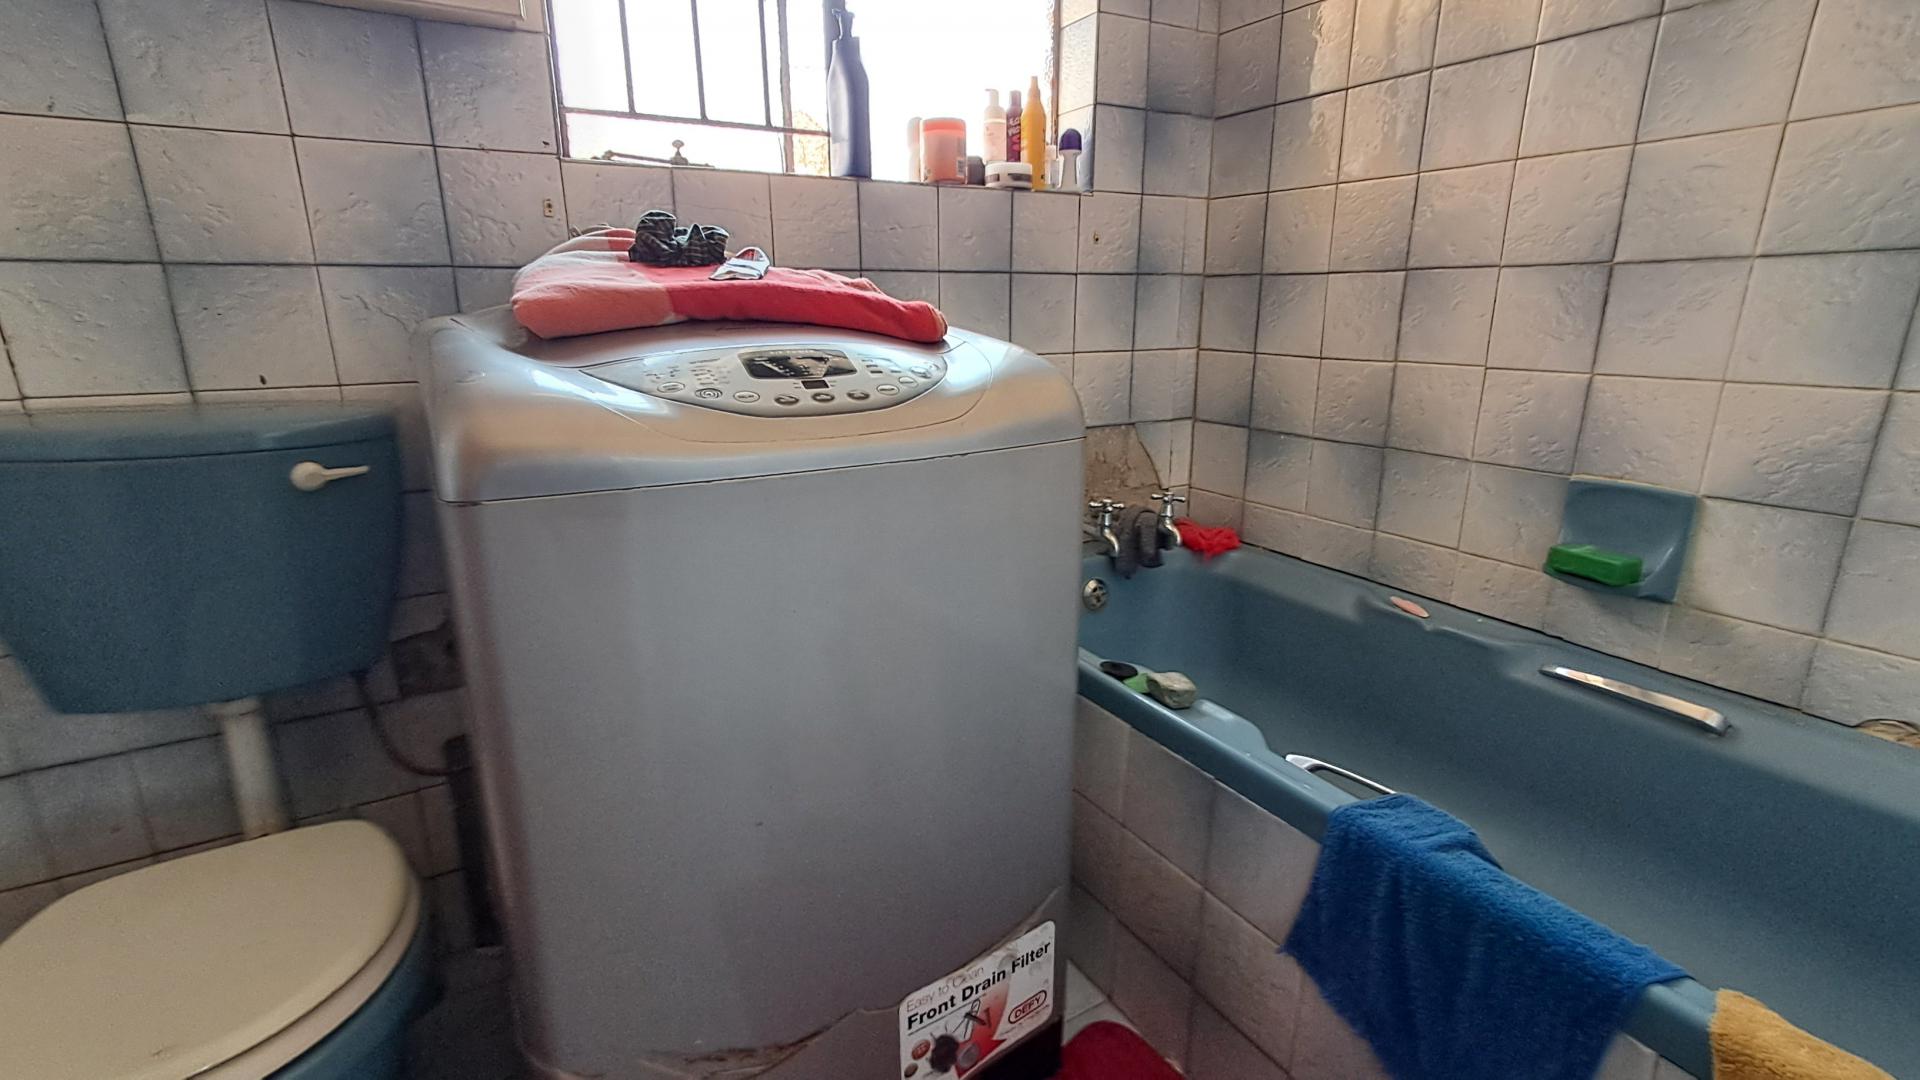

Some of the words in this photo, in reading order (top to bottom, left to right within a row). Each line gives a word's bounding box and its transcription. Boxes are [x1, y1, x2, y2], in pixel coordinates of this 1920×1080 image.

[906, 989, 936, 1012] Easy
[938, 983, 949, 997] to
[907, 995, 956, 1030] Front
[962, 969, 1006, 1001] Drain
[1011, 942, 1051, 973] Filter
[1014, 994, 1041, 1019] DEFY
